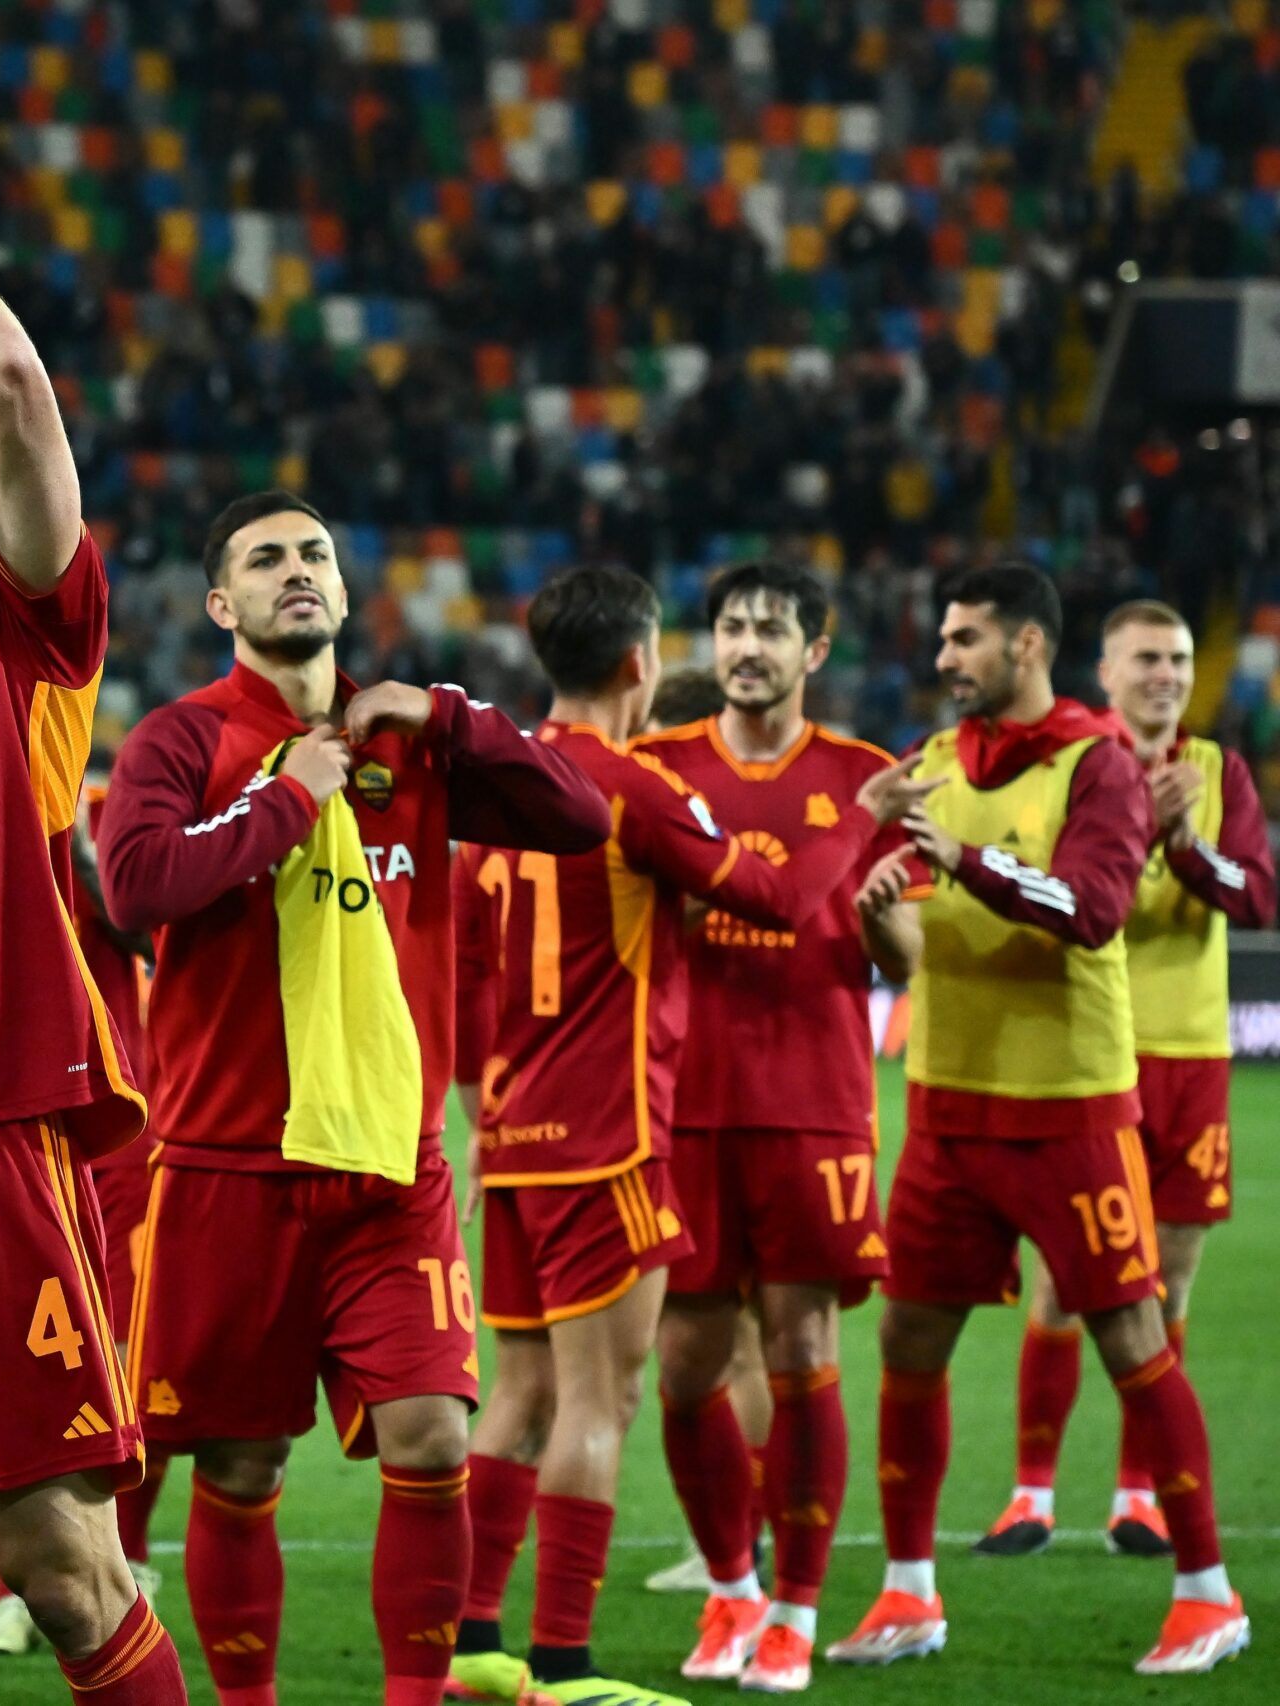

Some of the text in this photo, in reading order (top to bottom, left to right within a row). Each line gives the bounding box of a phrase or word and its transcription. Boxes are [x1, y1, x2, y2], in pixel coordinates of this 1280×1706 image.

[705, 928, 796, 948] SEASON
[816, 1153, 872, 1225] 17
[1071, 1184, 1137, 1256] 19
[26, 1276, 85, 1370] 4
[417, 1258, 477, 1334] 16
